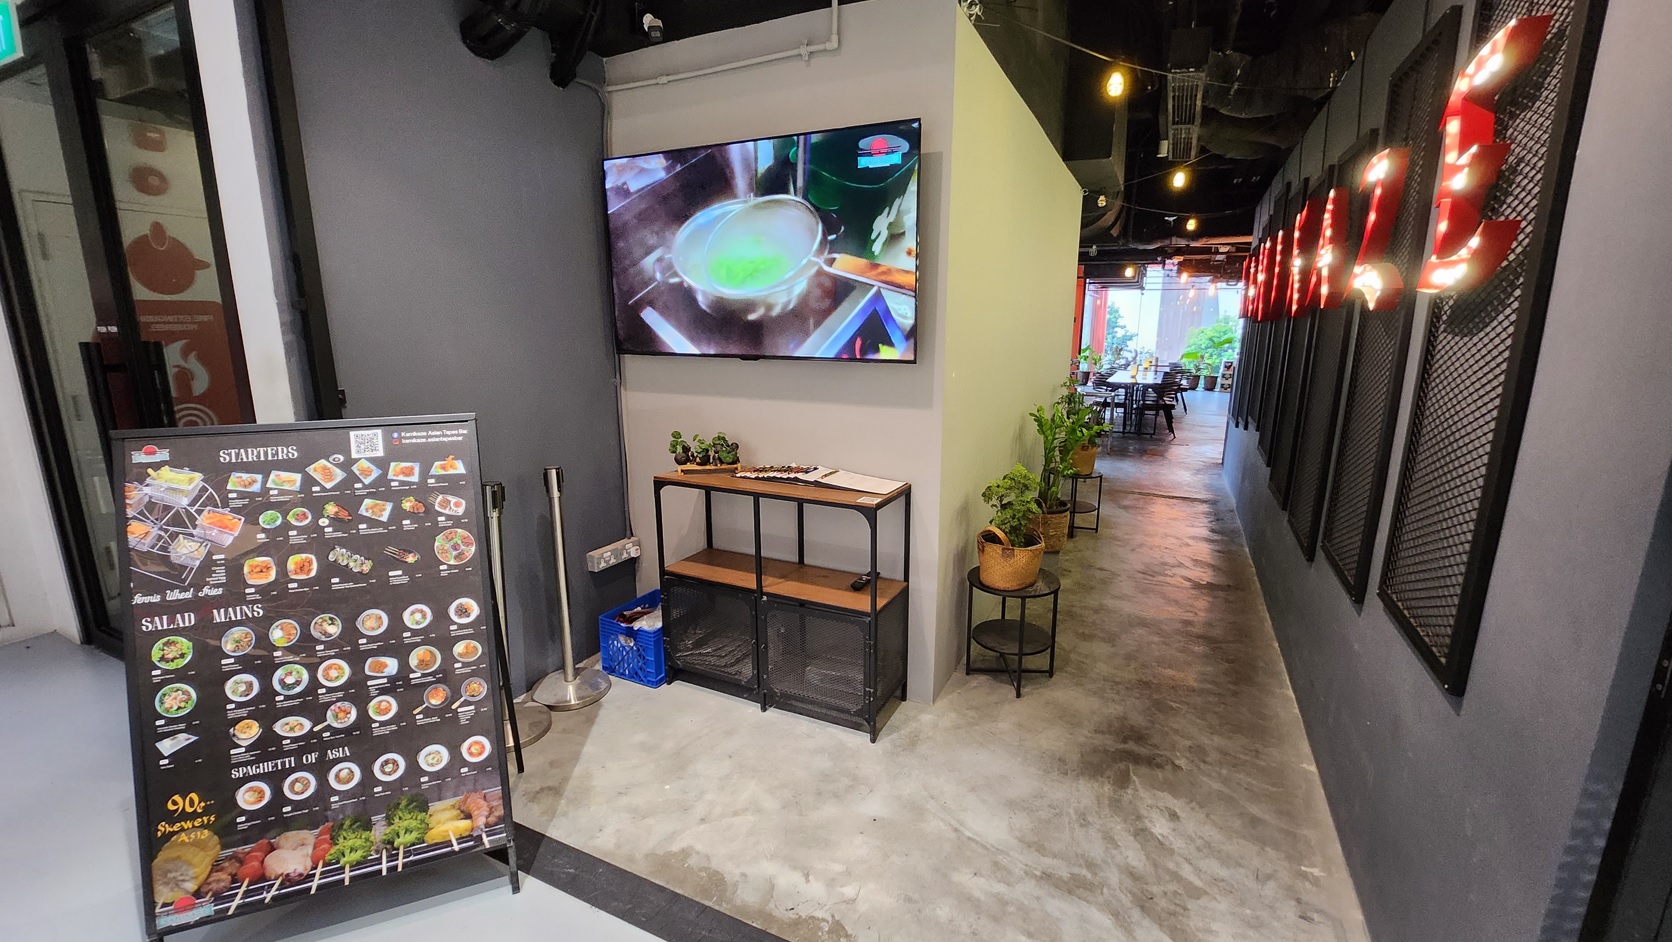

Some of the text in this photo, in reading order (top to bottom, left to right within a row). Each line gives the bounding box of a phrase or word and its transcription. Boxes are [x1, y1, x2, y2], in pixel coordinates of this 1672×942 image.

[219, 446, 298, 463] STARTERS
[165, 587, 194, 601] Wheel
[141, 612, 196, 632] SALAD
[212, 603, 264, 624] MAINS
[231, 746, 351, 779] SPAGHETTI OF ASIA
[157, 814, 216, 838] Skewers
